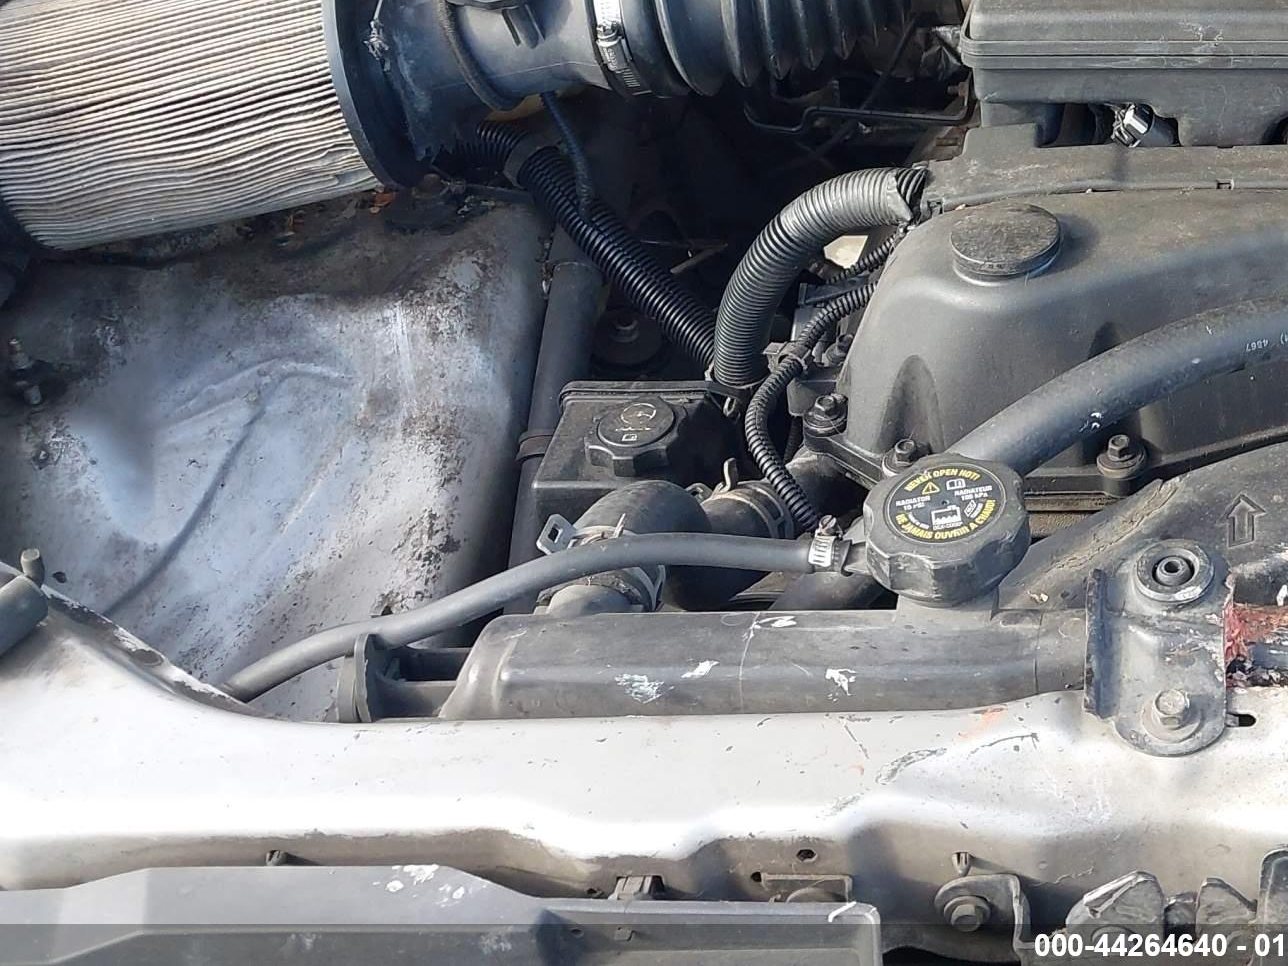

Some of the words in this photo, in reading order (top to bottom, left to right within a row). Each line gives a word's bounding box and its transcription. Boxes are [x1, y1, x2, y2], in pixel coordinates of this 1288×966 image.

[904, 472, 932, 492] NEVER
[933, 468, 958, 477] OPEN
[901, 521, 934, 539] JAMAIS
[934, 526, 970, 539] OUVRIR
